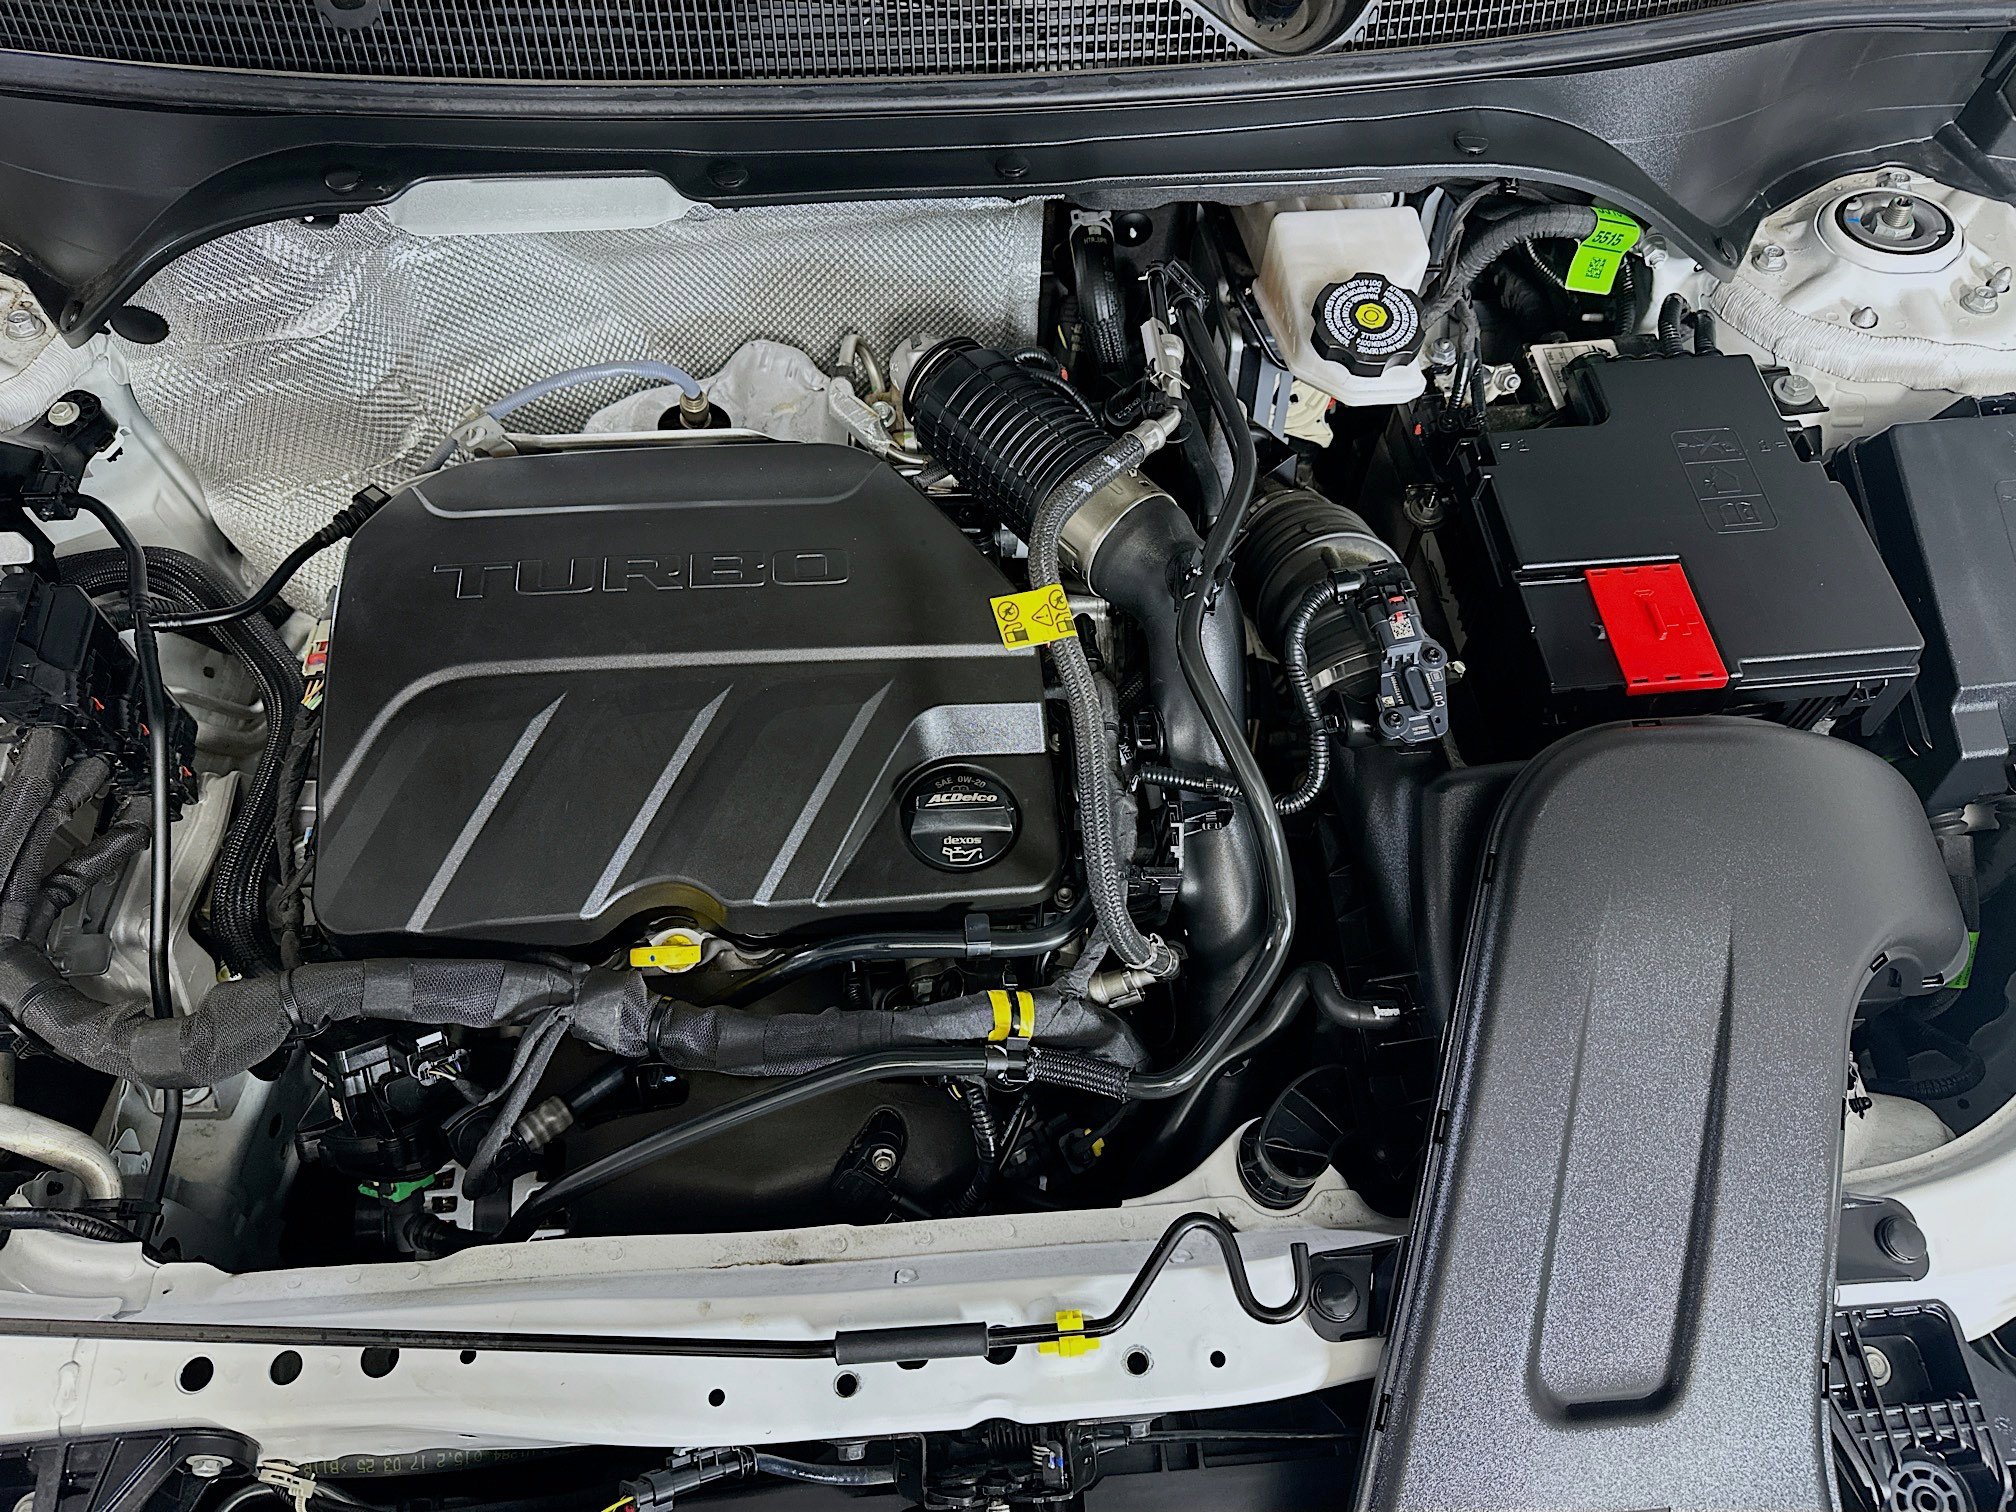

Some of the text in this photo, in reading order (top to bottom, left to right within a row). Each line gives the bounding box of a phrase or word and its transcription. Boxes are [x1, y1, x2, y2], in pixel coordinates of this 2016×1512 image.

[1591, 230, 1624, 247] 5515
[1344, 278, 1364, 289] FLUID
[1368, 278, 1383, 287] DOT
[1369, 285, 1381, 294] CAP
[1330, 283, 1349, 298] FROM
[1323, 298, 1335, 319] SEALED
[433, 548, 849, 599] TURBO
[934, 775, 986, 788] SAE 0W-20
[927, 792, 998, 804] ACDelco
[943, 835, 982, 845] dexos
[356, 1458, 376, 1474] 25
[383, 1456, 401, 1472] 03
[410, 1454, 426, 1471] 17
